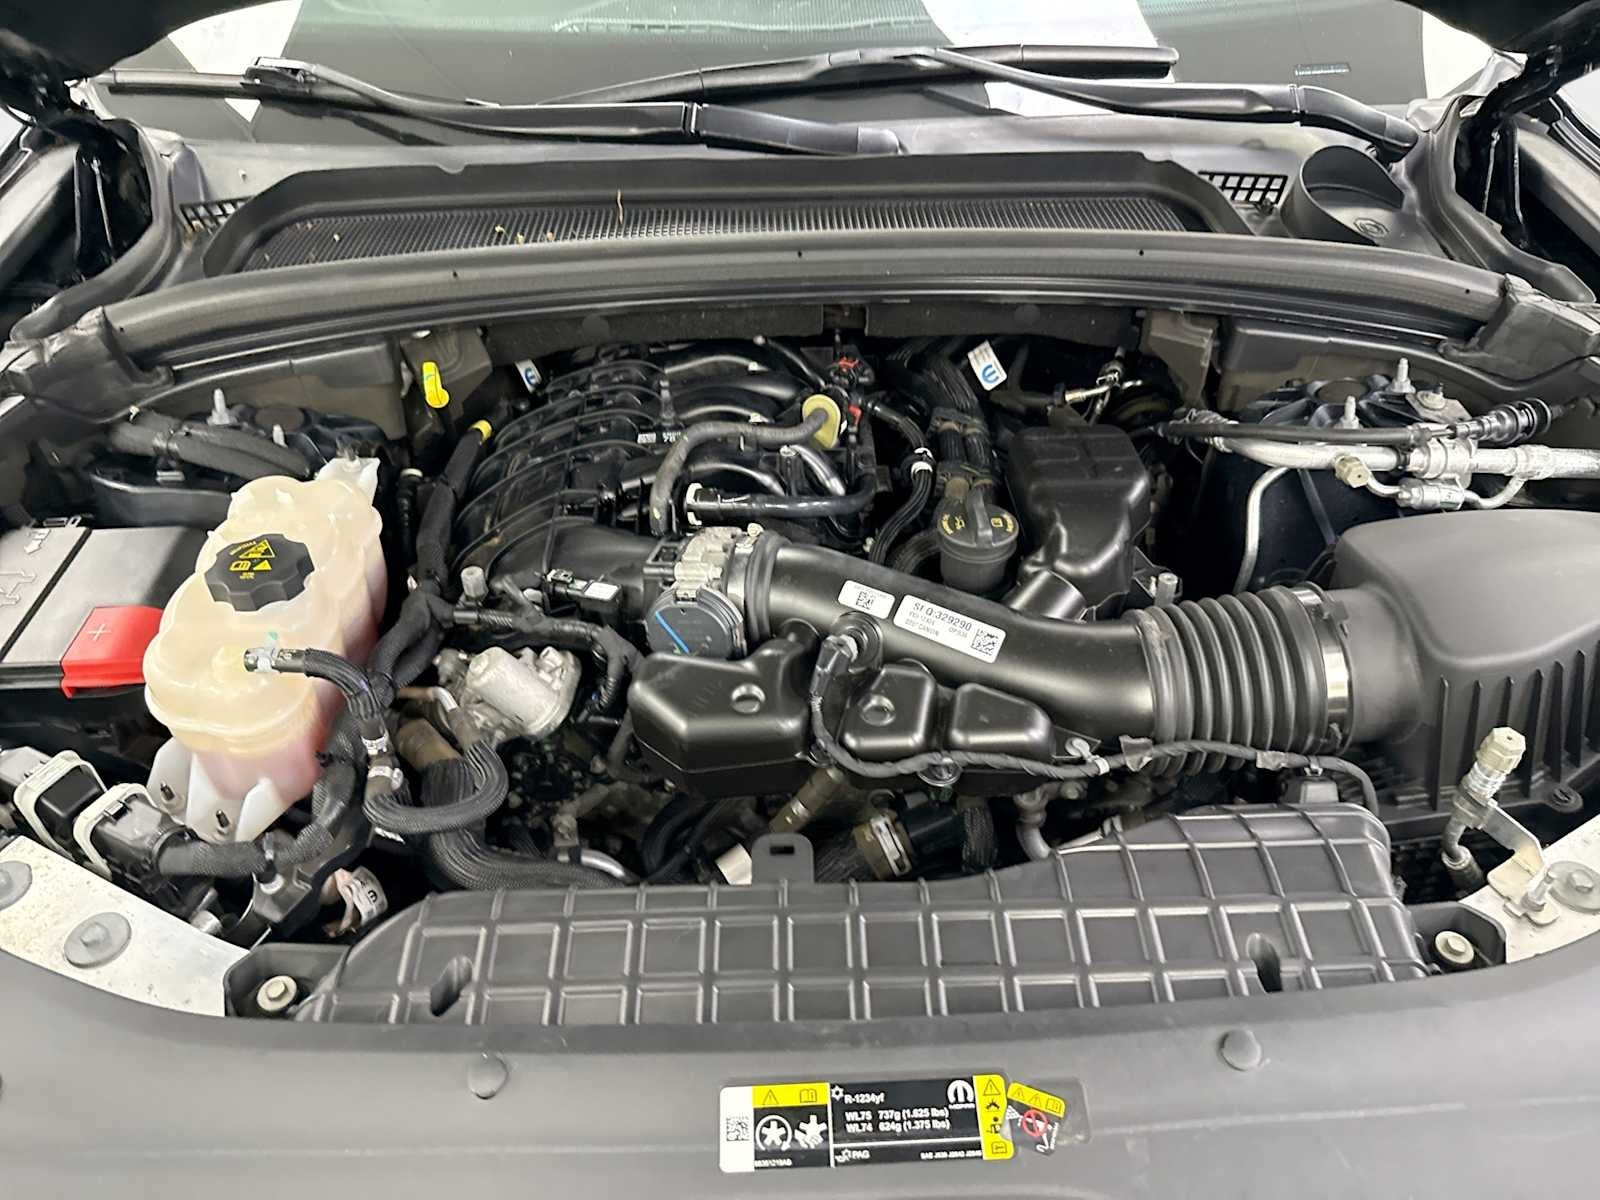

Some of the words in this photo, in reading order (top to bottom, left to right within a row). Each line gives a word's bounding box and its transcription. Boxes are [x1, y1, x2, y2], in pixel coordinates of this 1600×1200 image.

[845, 1110, 872, 1121] WL75
[878, 1109, 901, 1121] 737g
[930, 1106, 949, 1118] lbs)
[902, 1119, 931, 1132] (1.375
[931, 1118, 950, 1130] lbs)
[852, 1149, 870, 1160] PAG
